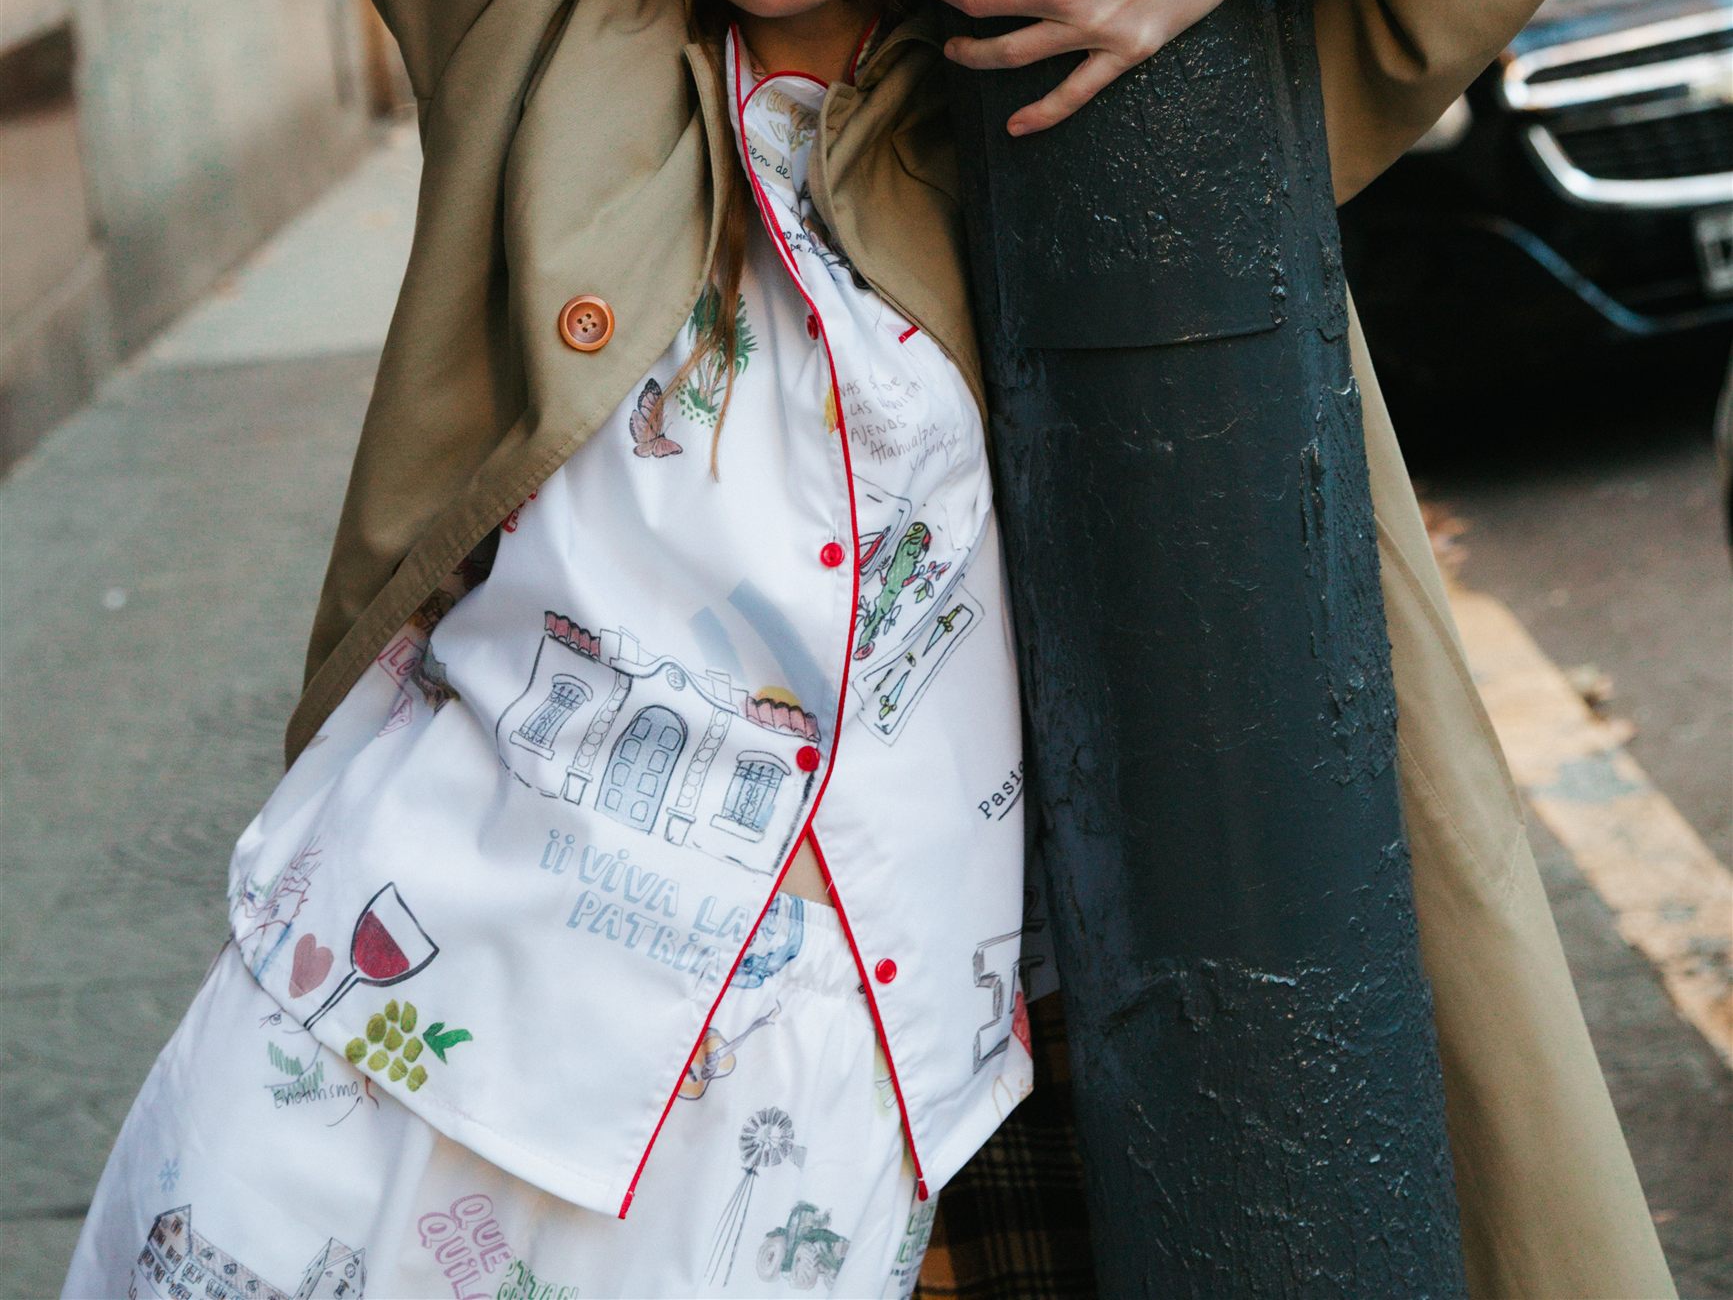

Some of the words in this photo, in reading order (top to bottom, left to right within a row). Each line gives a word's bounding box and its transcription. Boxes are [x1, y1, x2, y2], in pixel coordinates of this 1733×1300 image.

[776, 155, 790, 179] de
[850, 401, 872, 416] LAS
[870, 423, 938, 465] Atahualpa
[693, 895, 751, 943] LA
[450, 1194, 513, 1273] QUE
